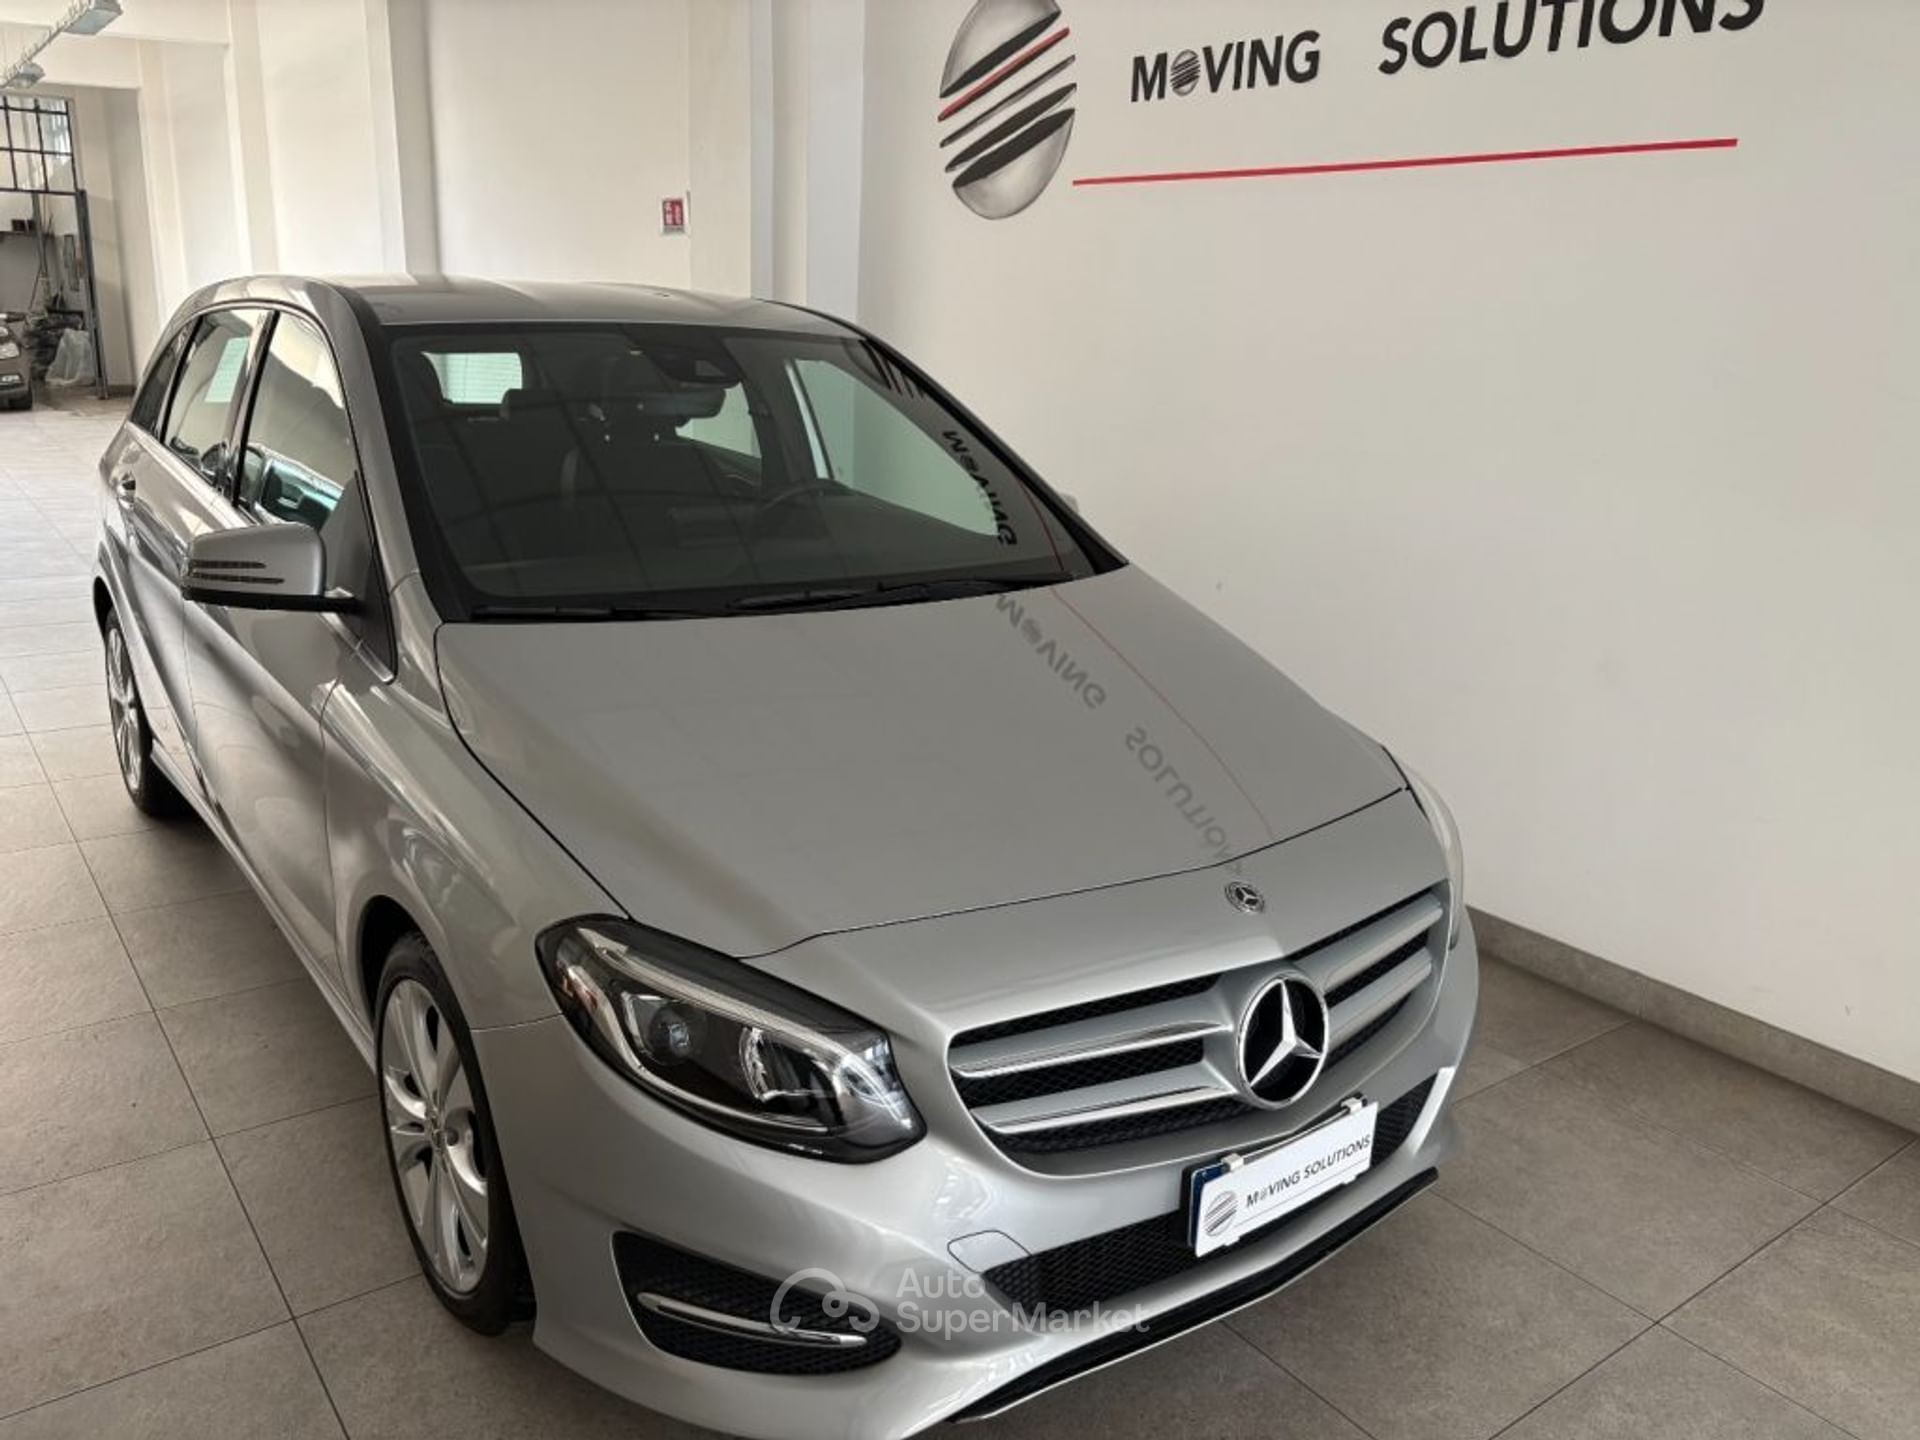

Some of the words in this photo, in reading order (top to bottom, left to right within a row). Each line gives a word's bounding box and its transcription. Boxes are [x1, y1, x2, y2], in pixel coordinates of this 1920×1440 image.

[1131, 30, 1320, 102] MOVING
[1246, 1170, 1301, 1208] MOVING
[1303, 1134, 1371, 1179] SOLUTIONS
